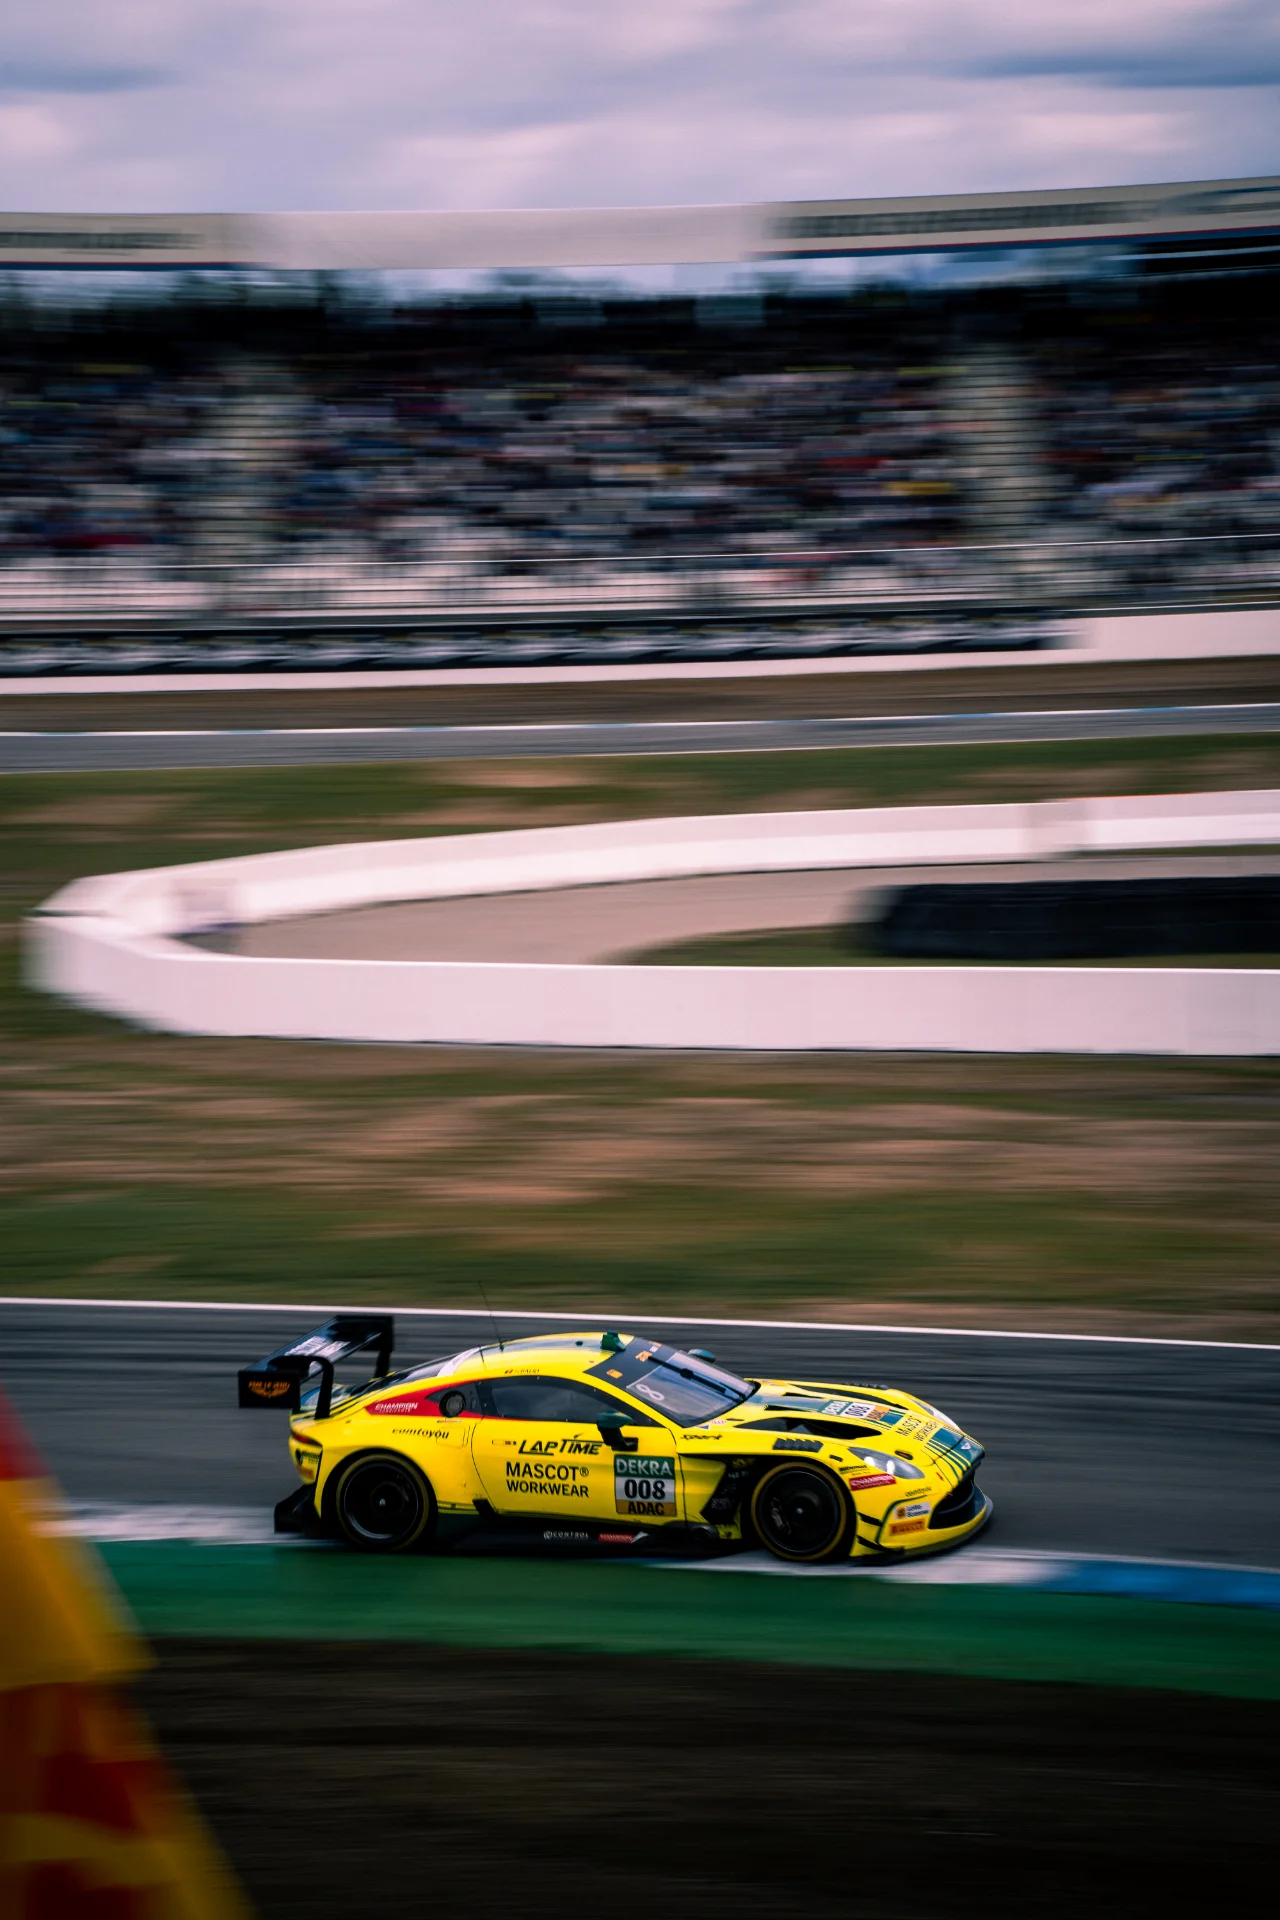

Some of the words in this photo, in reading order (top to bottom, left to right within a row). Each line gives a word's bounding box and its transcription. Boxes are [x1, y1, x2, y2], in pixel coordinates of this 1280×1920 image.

[375, 1402, 419, 1411] CHAMPION
[616, 1458, 673, 1476] DEKRA
[506, 1480, 589, 1498] WORKWEAR
[624, 1479, 666, 1500] 008
[628, 1501, 665, 1516] ADAC
